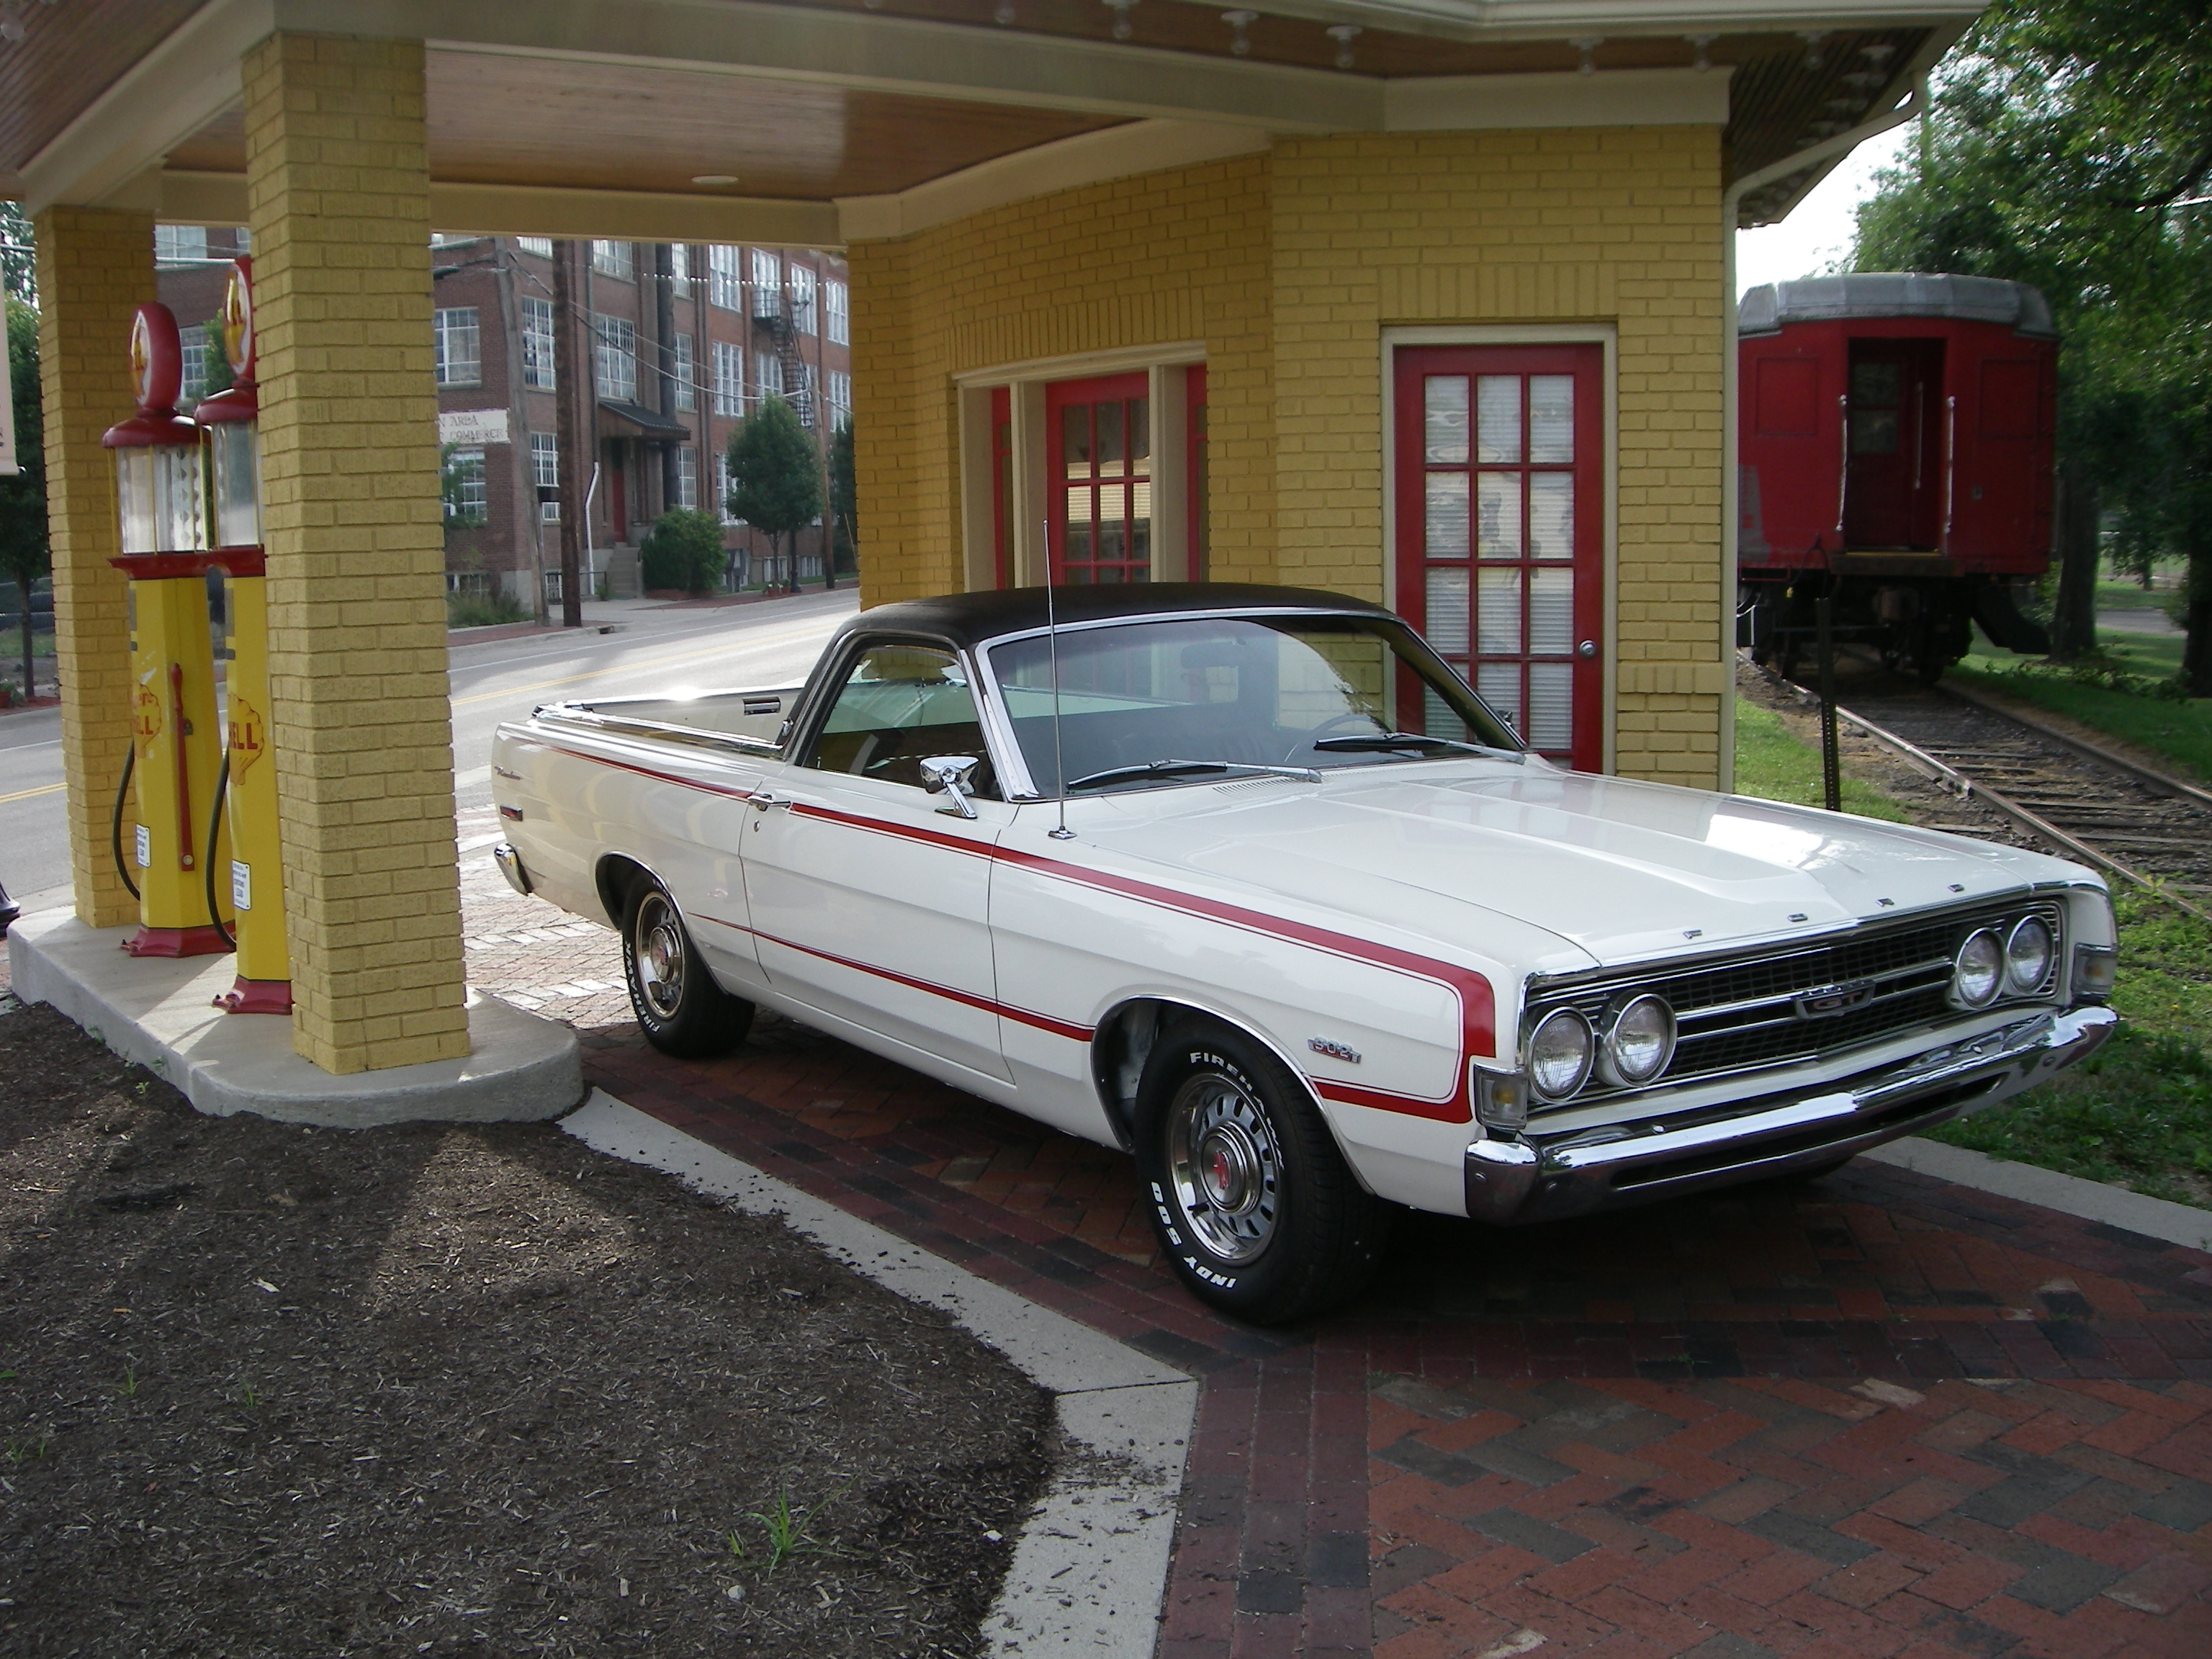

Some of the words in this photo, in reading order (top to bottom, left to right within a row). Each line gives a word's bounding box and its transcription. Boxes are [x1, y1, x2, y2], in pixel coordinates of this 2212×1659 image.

[449, 428, 504, 441] COMMERCE
[624, 940, 660, 1033] FIREHAWK
[1813, 991, 1863, 1010] GT
[1314, 1037, 1353, 1060] 302
[1189, 1051, 1285, 1170] FIREHAWK
[1151, 1181, 1182, 1246] 500
[1182, 1255, 1237, 1288] INDY
